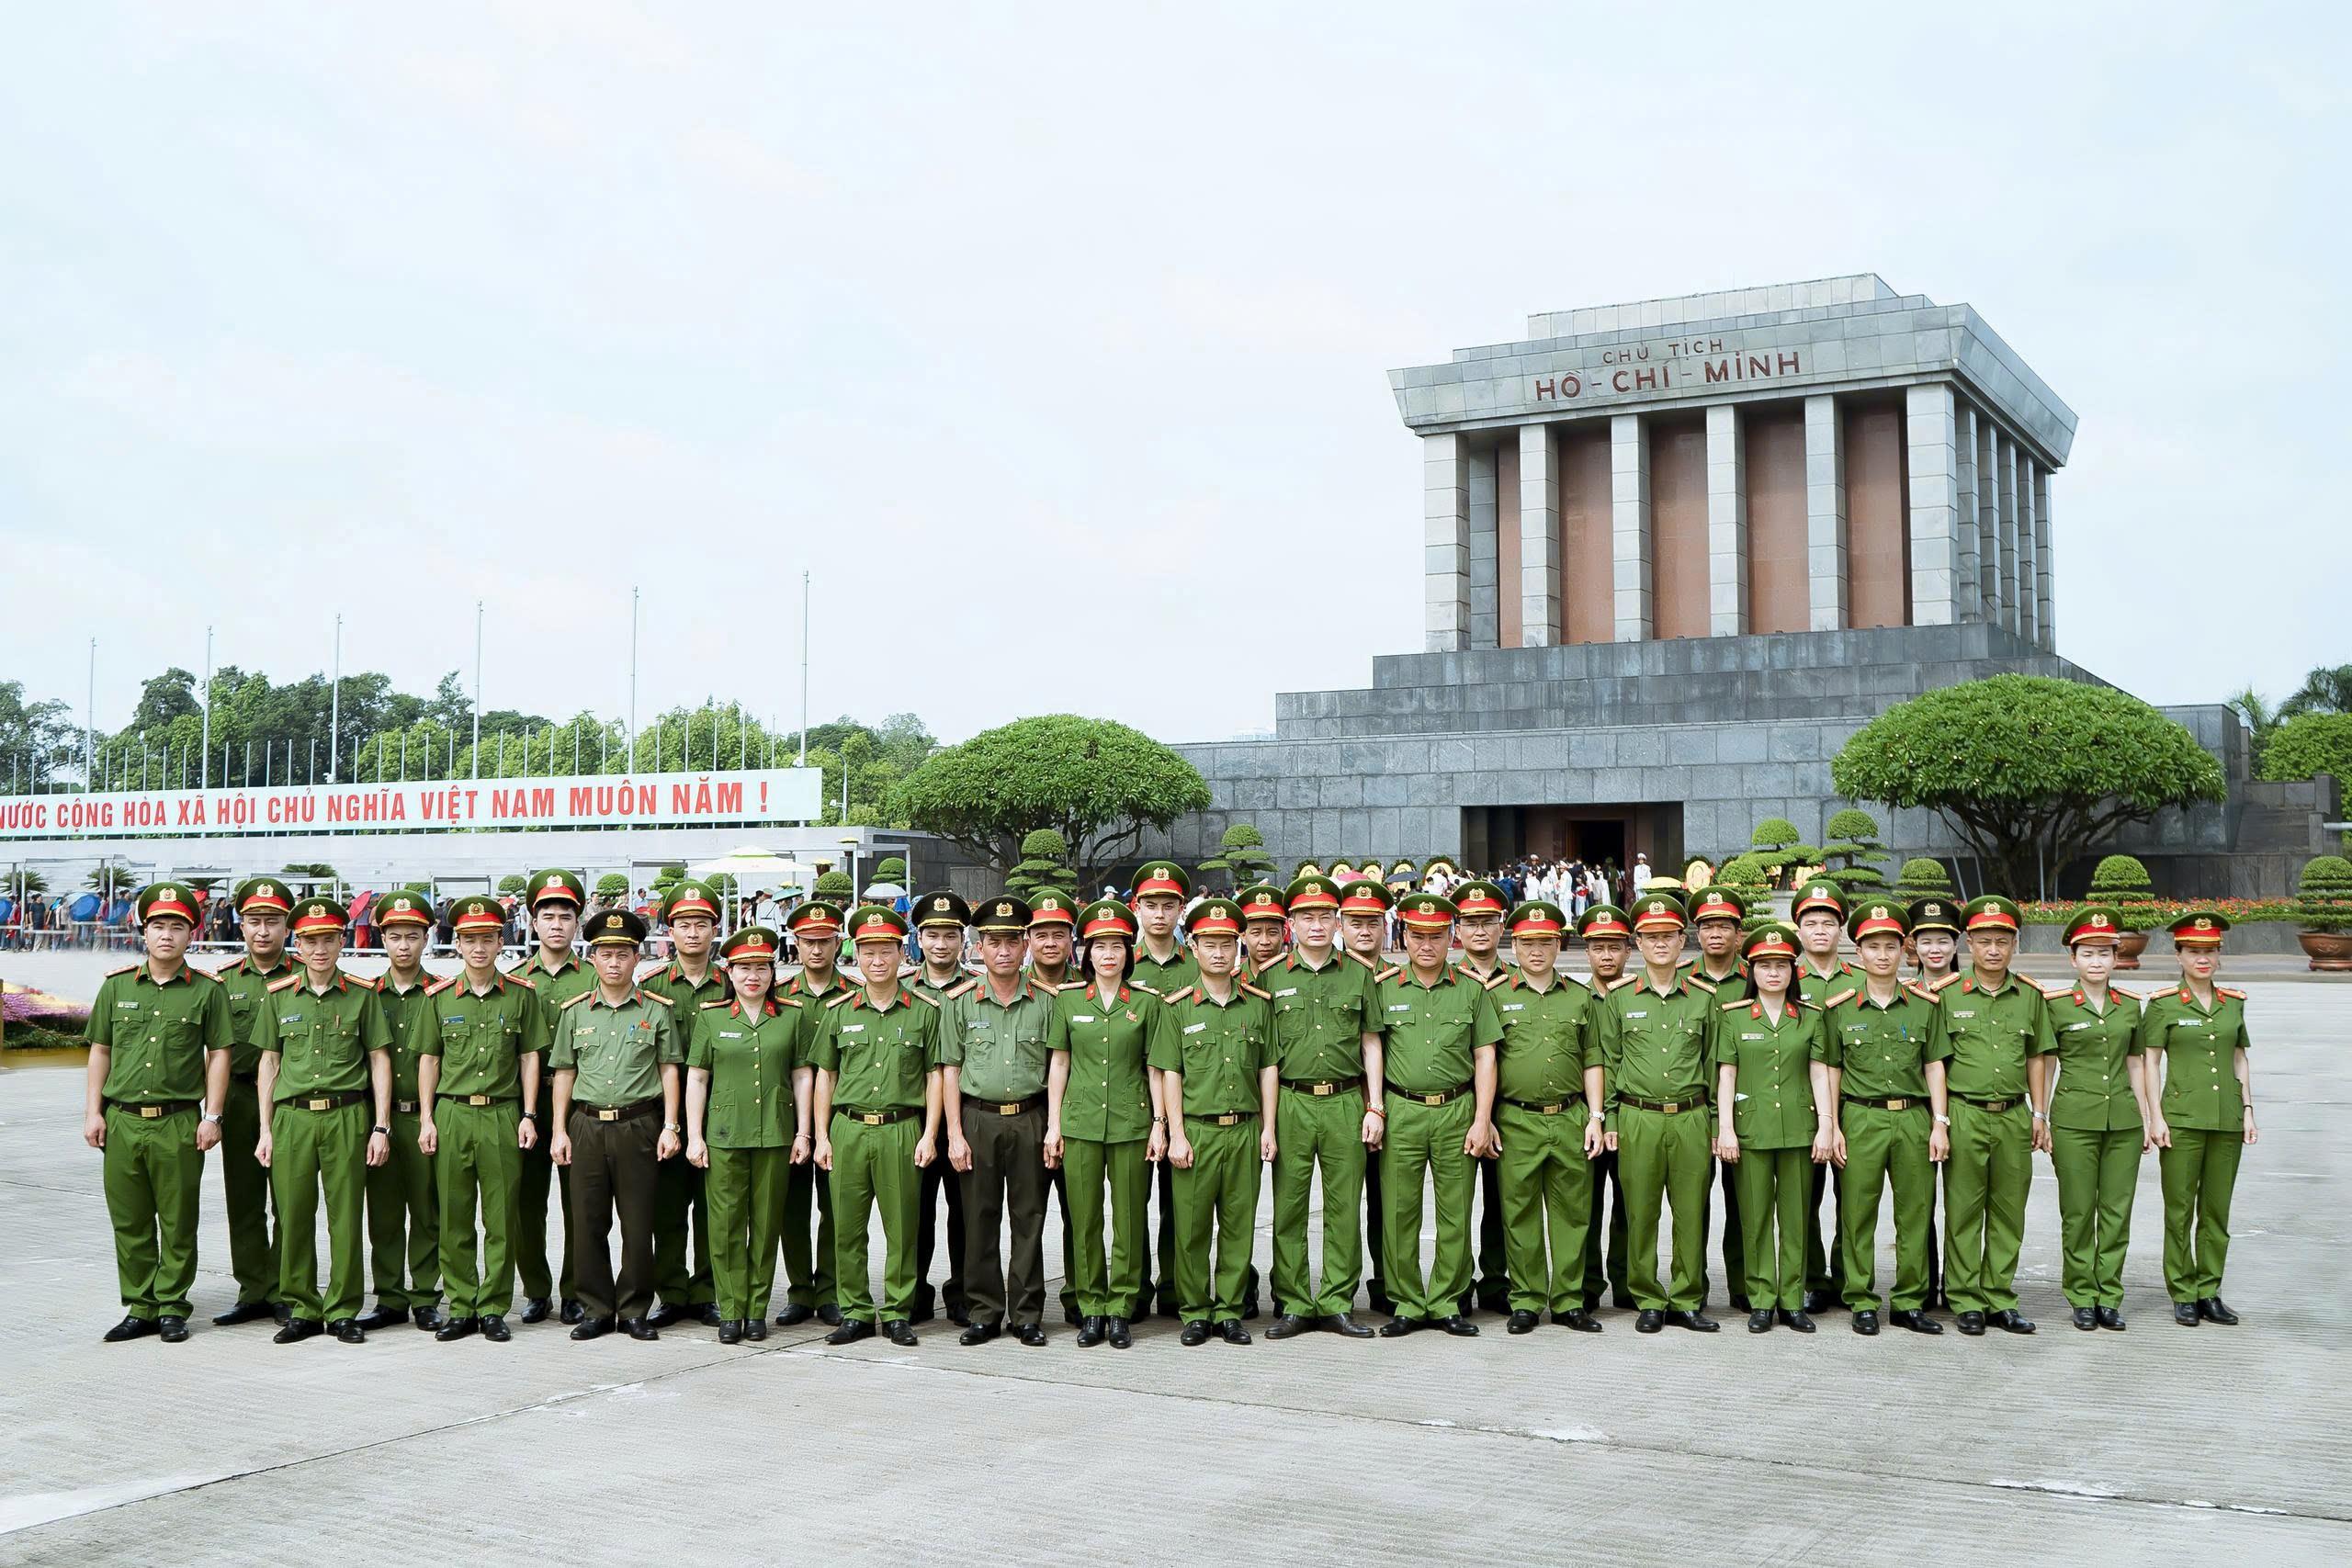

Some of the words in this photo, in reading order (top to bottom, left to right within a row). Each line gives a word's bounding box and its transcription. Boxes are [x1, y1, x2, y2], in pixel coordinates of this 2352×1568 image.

[1612, 360, 1670, 392] CHÍ
[1704, 350, 1801, 383] MINH
[57, 797, 113, 832] CỘNG
[123, 796, 166, 827] HÒA
[177, 795, 206, 826] XÃ
[218, 793, 255, 829] HỘI
[267, 787, 315, 823] CHỦ
[327, 788, 405, 822] NGHĨA
[421, 784, 479, 825] VIỆT
[492, 788, 555, 818] NAM
[570, 779, 658, 817] MUÔN
[672, 776, 743, 815] NĂM
